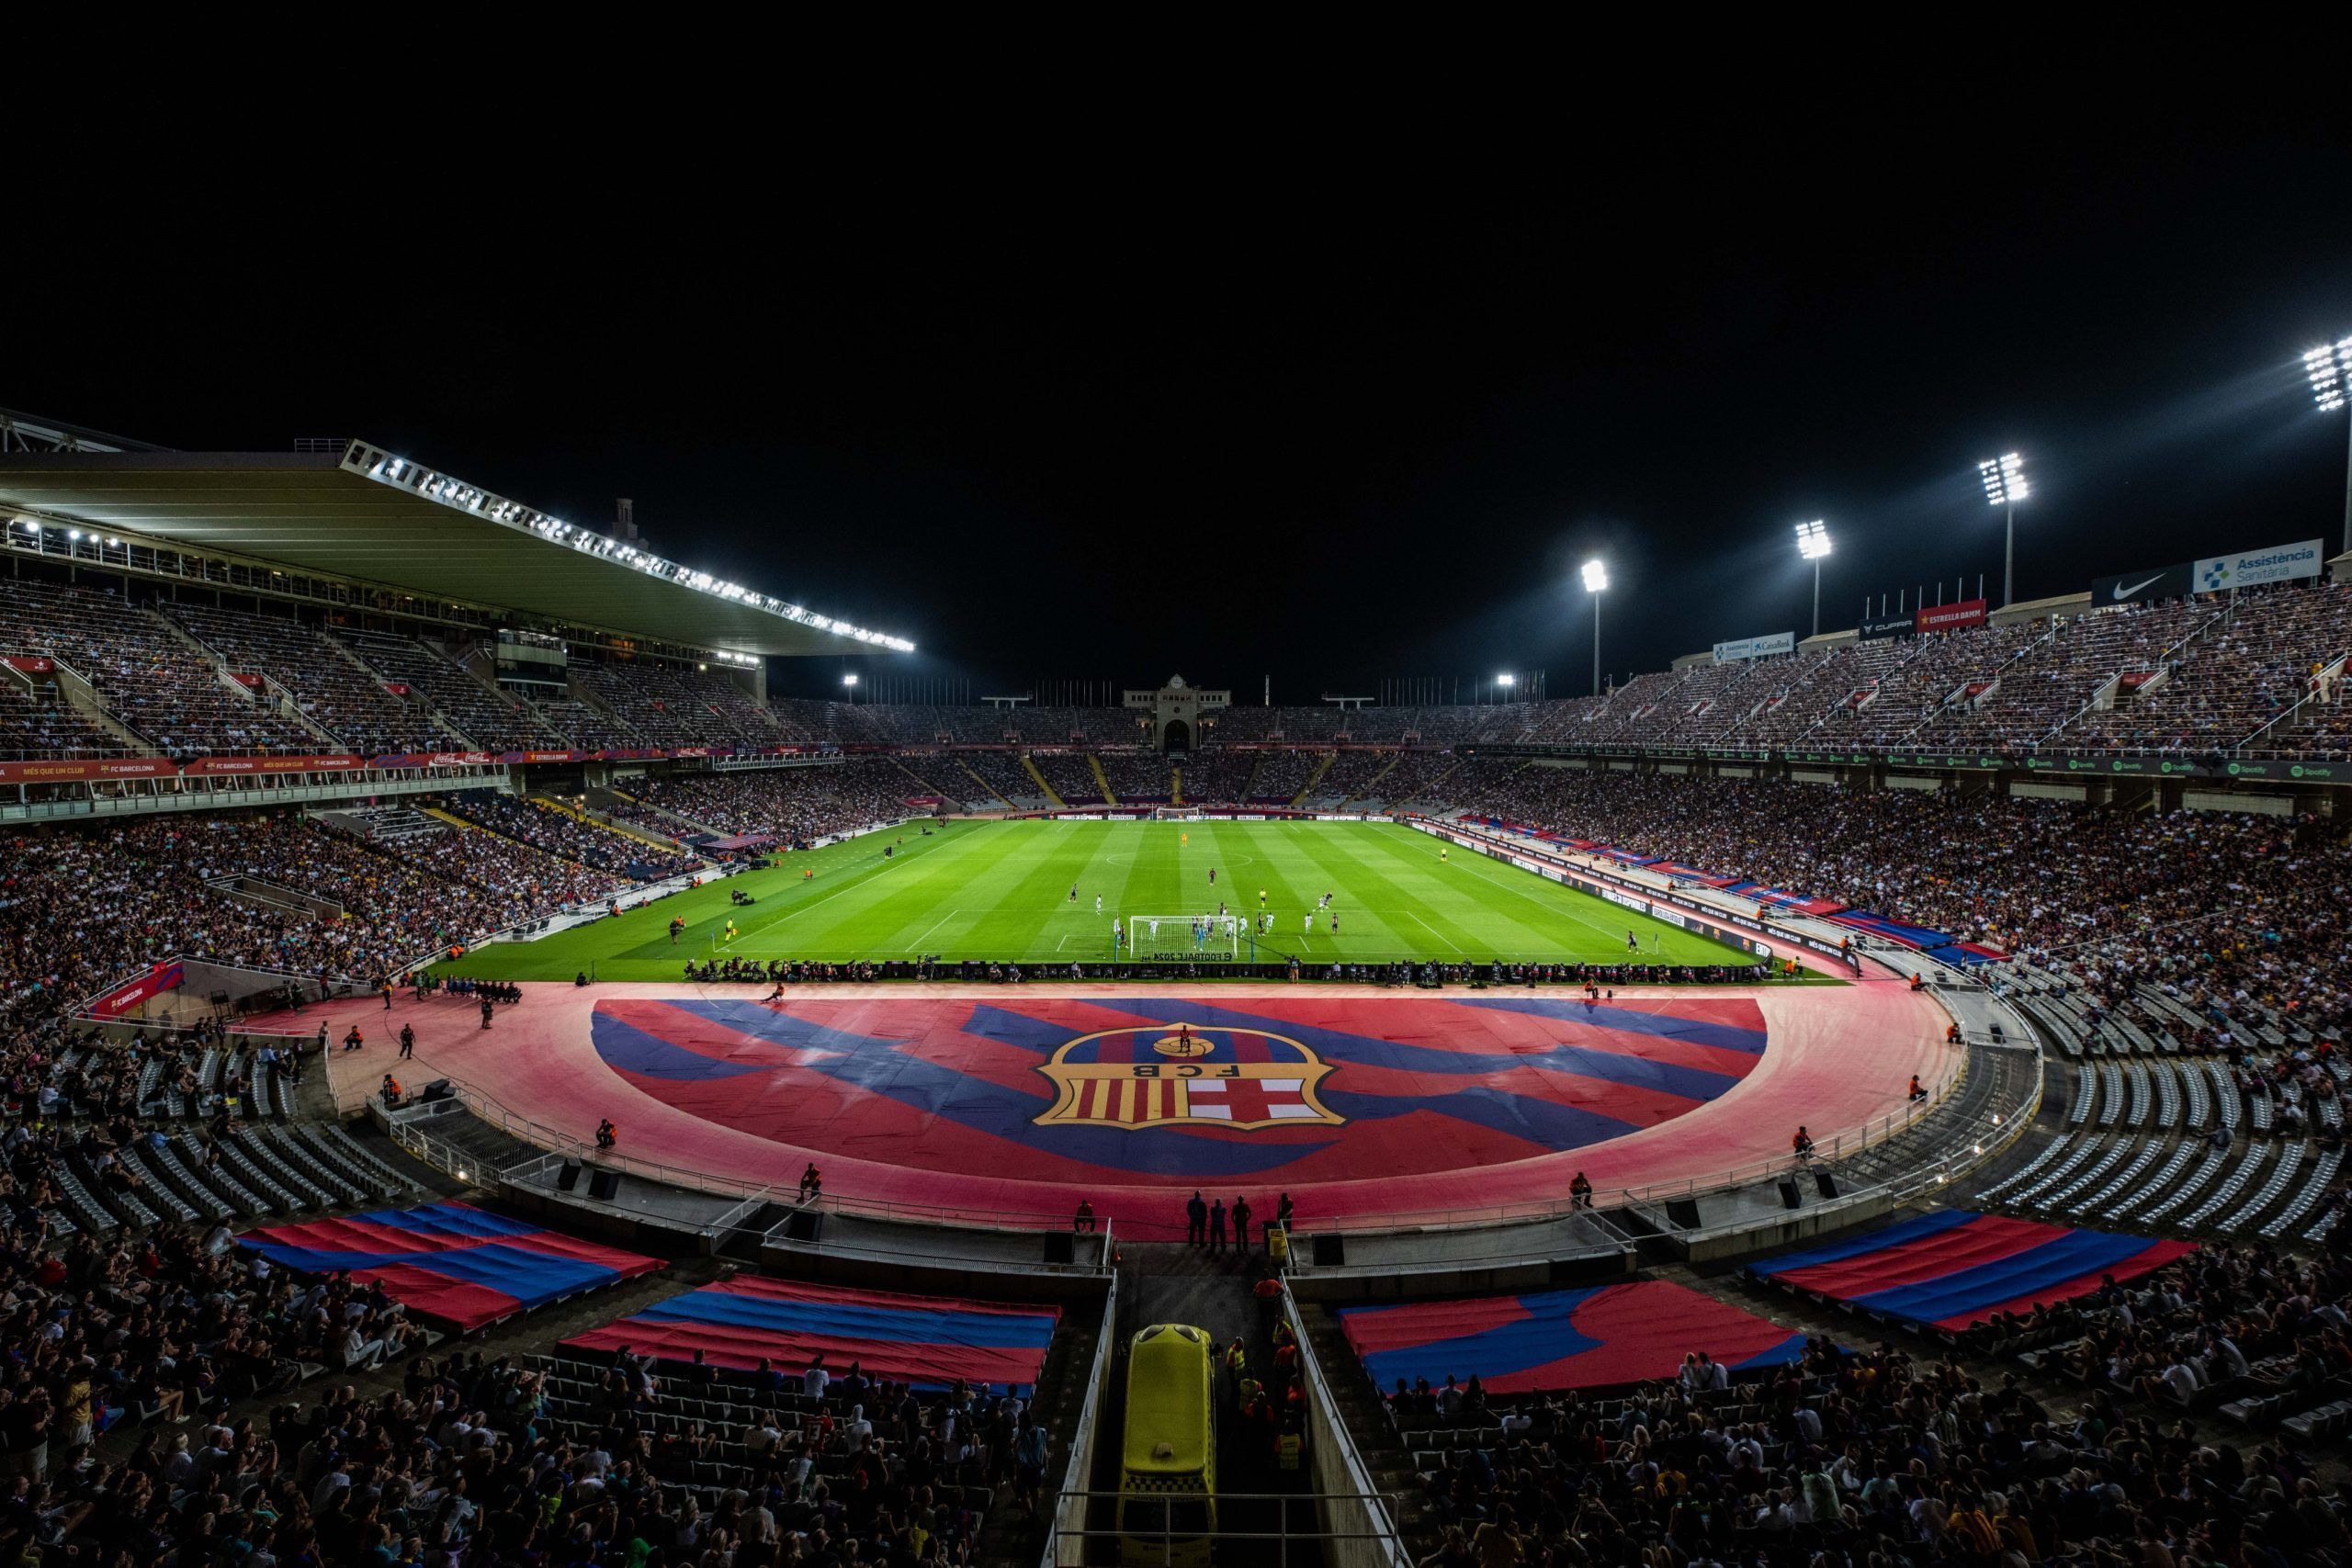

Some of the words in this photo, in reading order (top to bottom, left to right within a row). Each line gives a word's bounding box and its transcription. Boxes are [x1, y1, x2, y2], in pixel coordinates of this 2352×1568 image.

[2237, 548, 2313, 570] Assistència
[2237, 566, 2290, 582] Sanitària
[1929, 613, 1959, 624] ESTRELLA
[1960, 609, 1981, 620] DAMM
[1875, 620, 1912, 631] CUPRA
[1762, 639, 1790, 650] CaixaBank
[435, 753, 457, 762] Coca-Cola
[465, 752, 485, 762] Coca-Cola
[2036, 760, 2053, 768] Spotify
[2077, 761, 2095, 769] Spotify
[2122, 762, 2143, 771] Spotify
[2172, 763, 2196, 772] Spotify
[23, 766, 36, 775] MÉS
[40, 767, 54, 775] QUE
[2240, 765, 2267, 774] Spotify
[2303, 767, 2332, 777] Spotify
[1790, 934, 1802, 943] CLUB
[1808, 940, 1818, 949] MÉS
[1817, 943, 1826, 952] QUE
[1826, 946, 1833, 954] UN
[1833, 949, 1842, 958] CLUB
[117, 998, 122, 1008] FC
[122, 987, 142, 1005] BARCELONA
